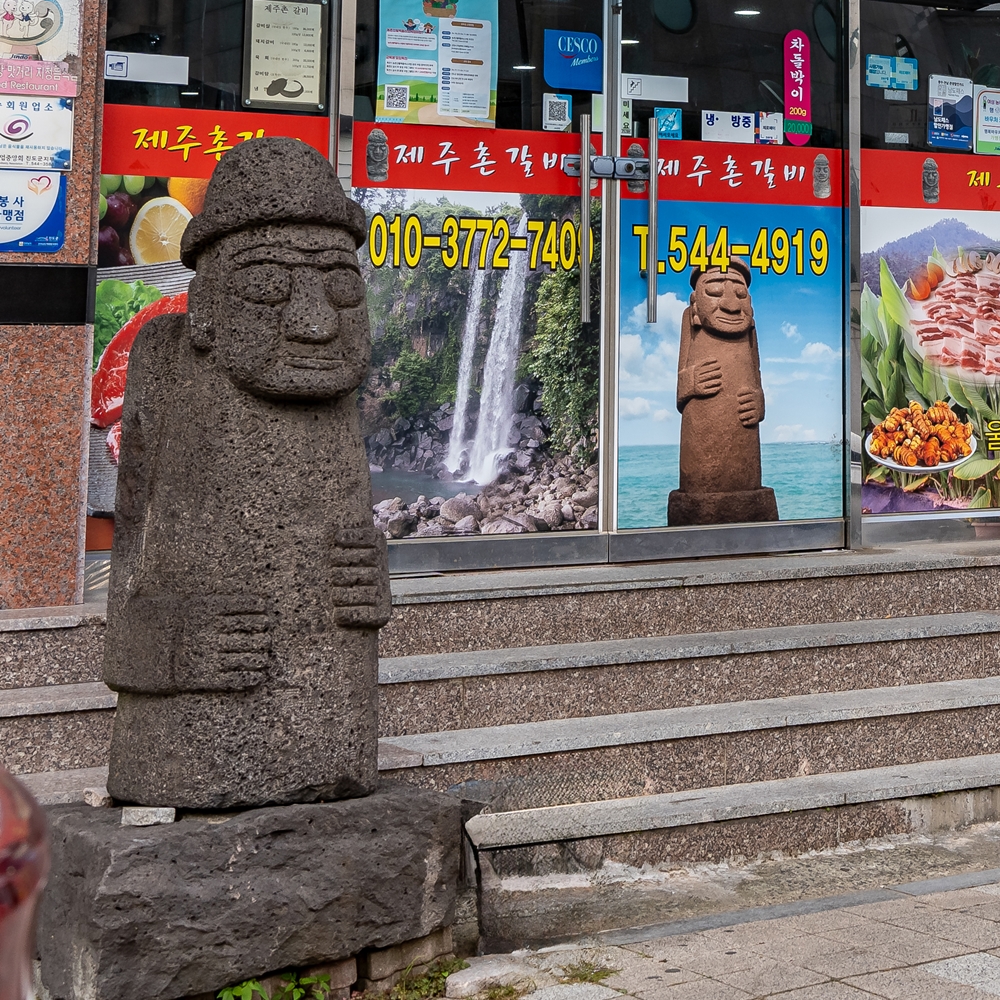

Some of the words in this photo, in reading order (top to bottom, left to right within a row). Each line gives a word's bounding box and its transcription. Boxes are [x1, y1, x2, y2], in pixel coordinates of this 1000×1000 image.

[264, 3, 289, 15] 제주촌
[293, 6, 309, 16] 갈비
[557, 35, 599, 55] CESCO
[570, 54, 600, 68] Members
[8, 65, 33, 79] 맛거리
[789, 36, 805, 102] 차돌박이
[10, 81, 59, 92] Restaurant
[0, 100, 54, 112] 회원업소
[788, 106, 808, 117] 200g
[621, 99, 631, 129] 미세요
[984, 115, 999, 123] 바우처
[731, 115, 752, 129] 방중
[786, 122, 811, 134] 20,000
[132, 125, 265, 162] 제주촌
[393, 140, 566, 178] 제주촌갈비
[657, 153, 806, 190] 제주촌갈비
[0, 209, 25, 222] 맹점
